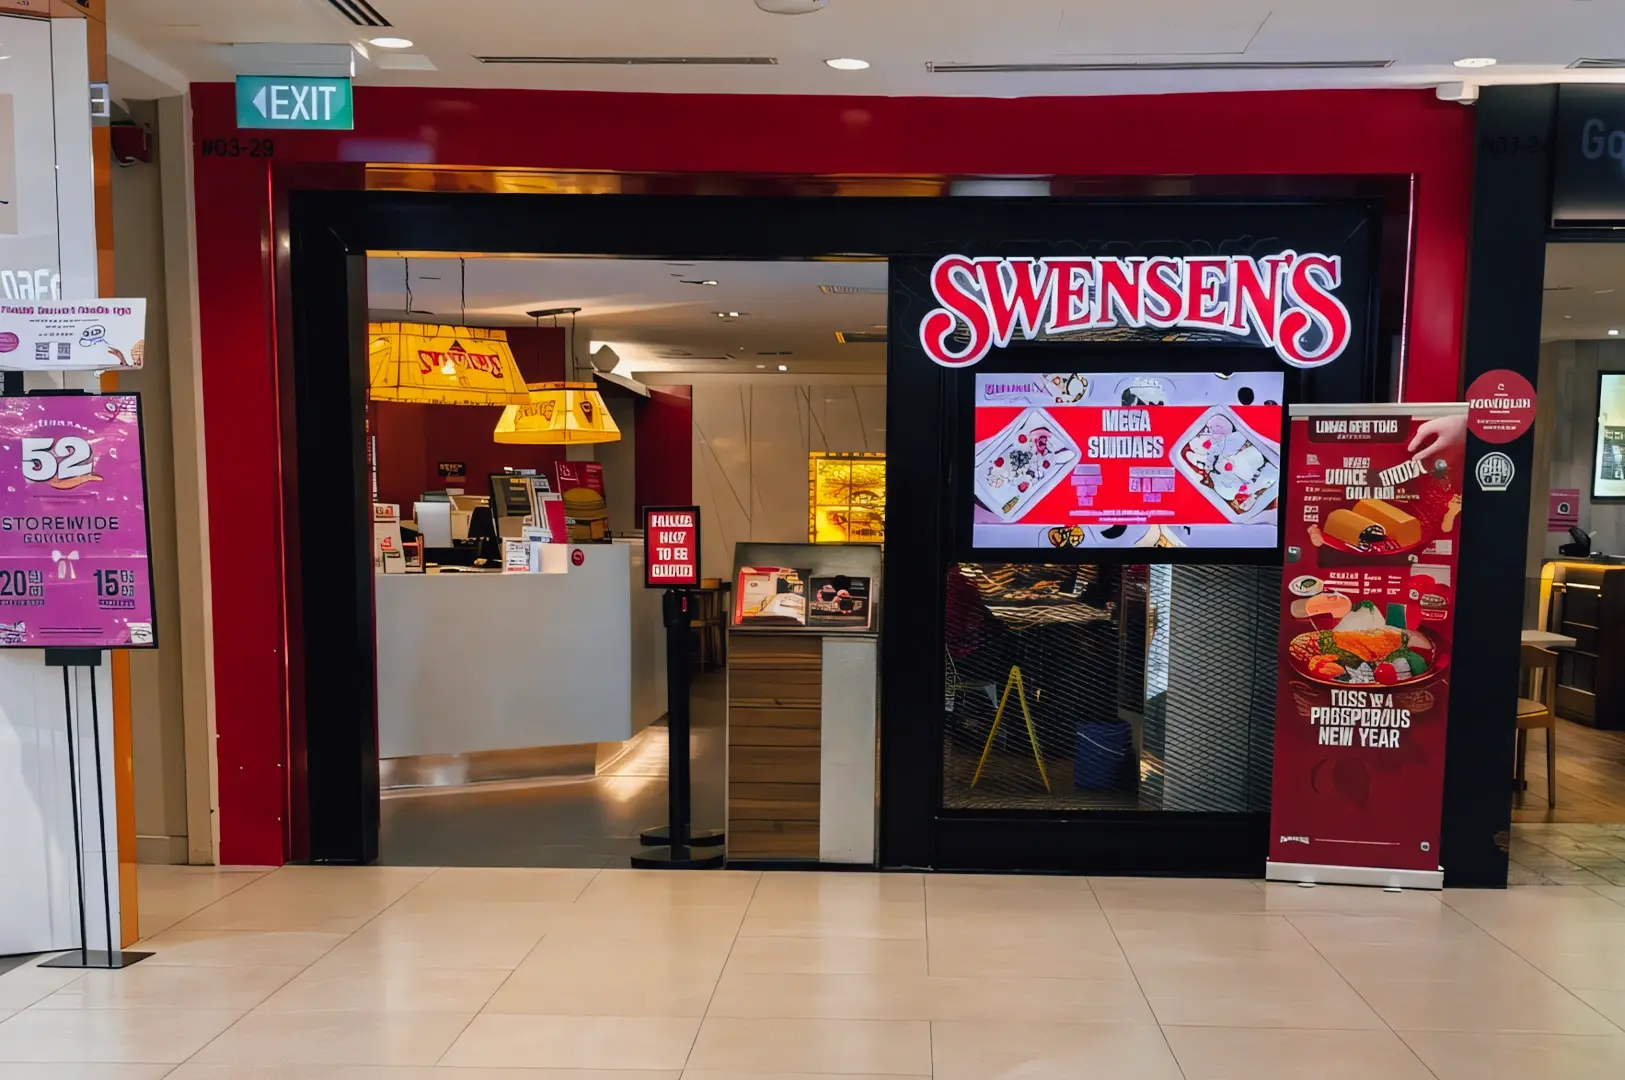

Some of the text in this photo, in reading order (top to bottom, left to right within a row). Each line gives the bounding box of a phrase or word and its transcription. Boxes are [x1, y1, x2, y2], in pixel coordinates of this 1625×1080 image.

[270, 85, 337, 120] EXIT
[919, 248, 1351, 368] SWENSEN'S
[1102, 409, 1151, 432] MEGA
[2, 516, 119, 531] STOREWIDE
[1358, 727, 1401, 749] YEAR
